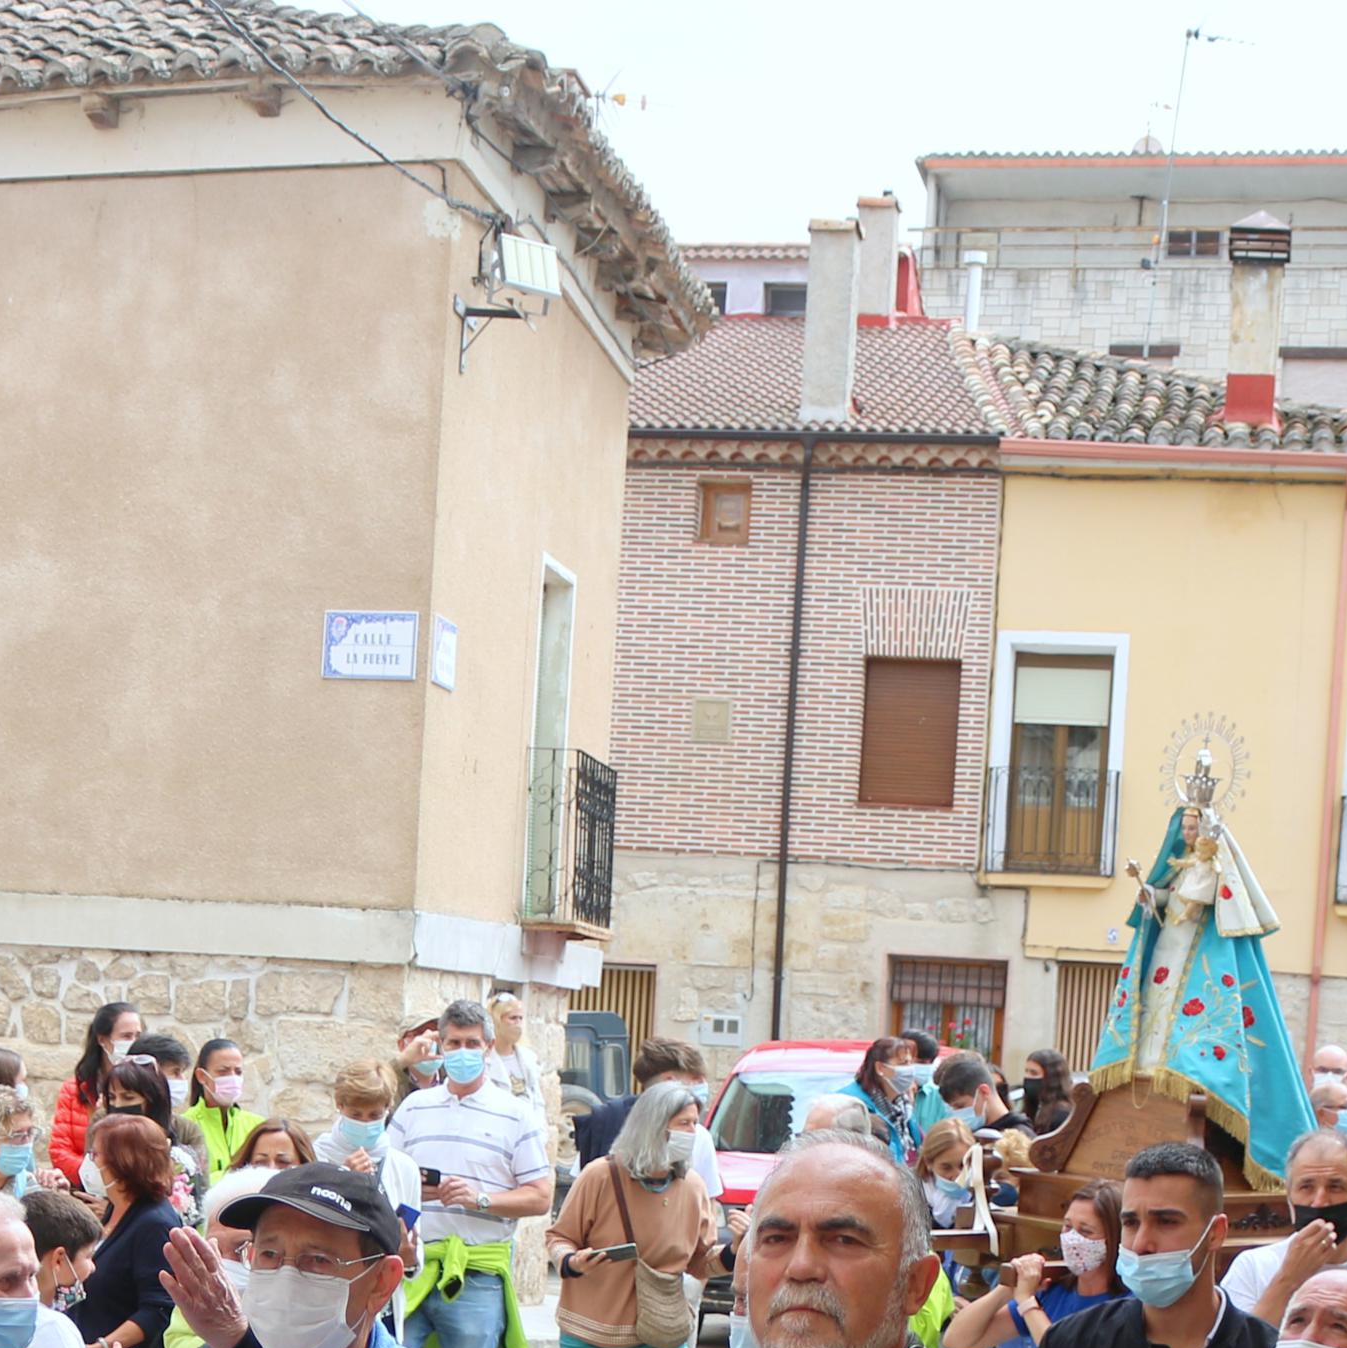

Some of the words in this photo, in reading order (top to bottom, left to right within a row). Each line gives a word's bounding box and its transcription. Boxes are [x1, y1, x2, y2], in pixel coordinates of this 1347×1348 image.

[354, 634, 392, 645] CALLE
[346, 653, 358, 665] LA
[363, 653, 401, 665] FUENTE
